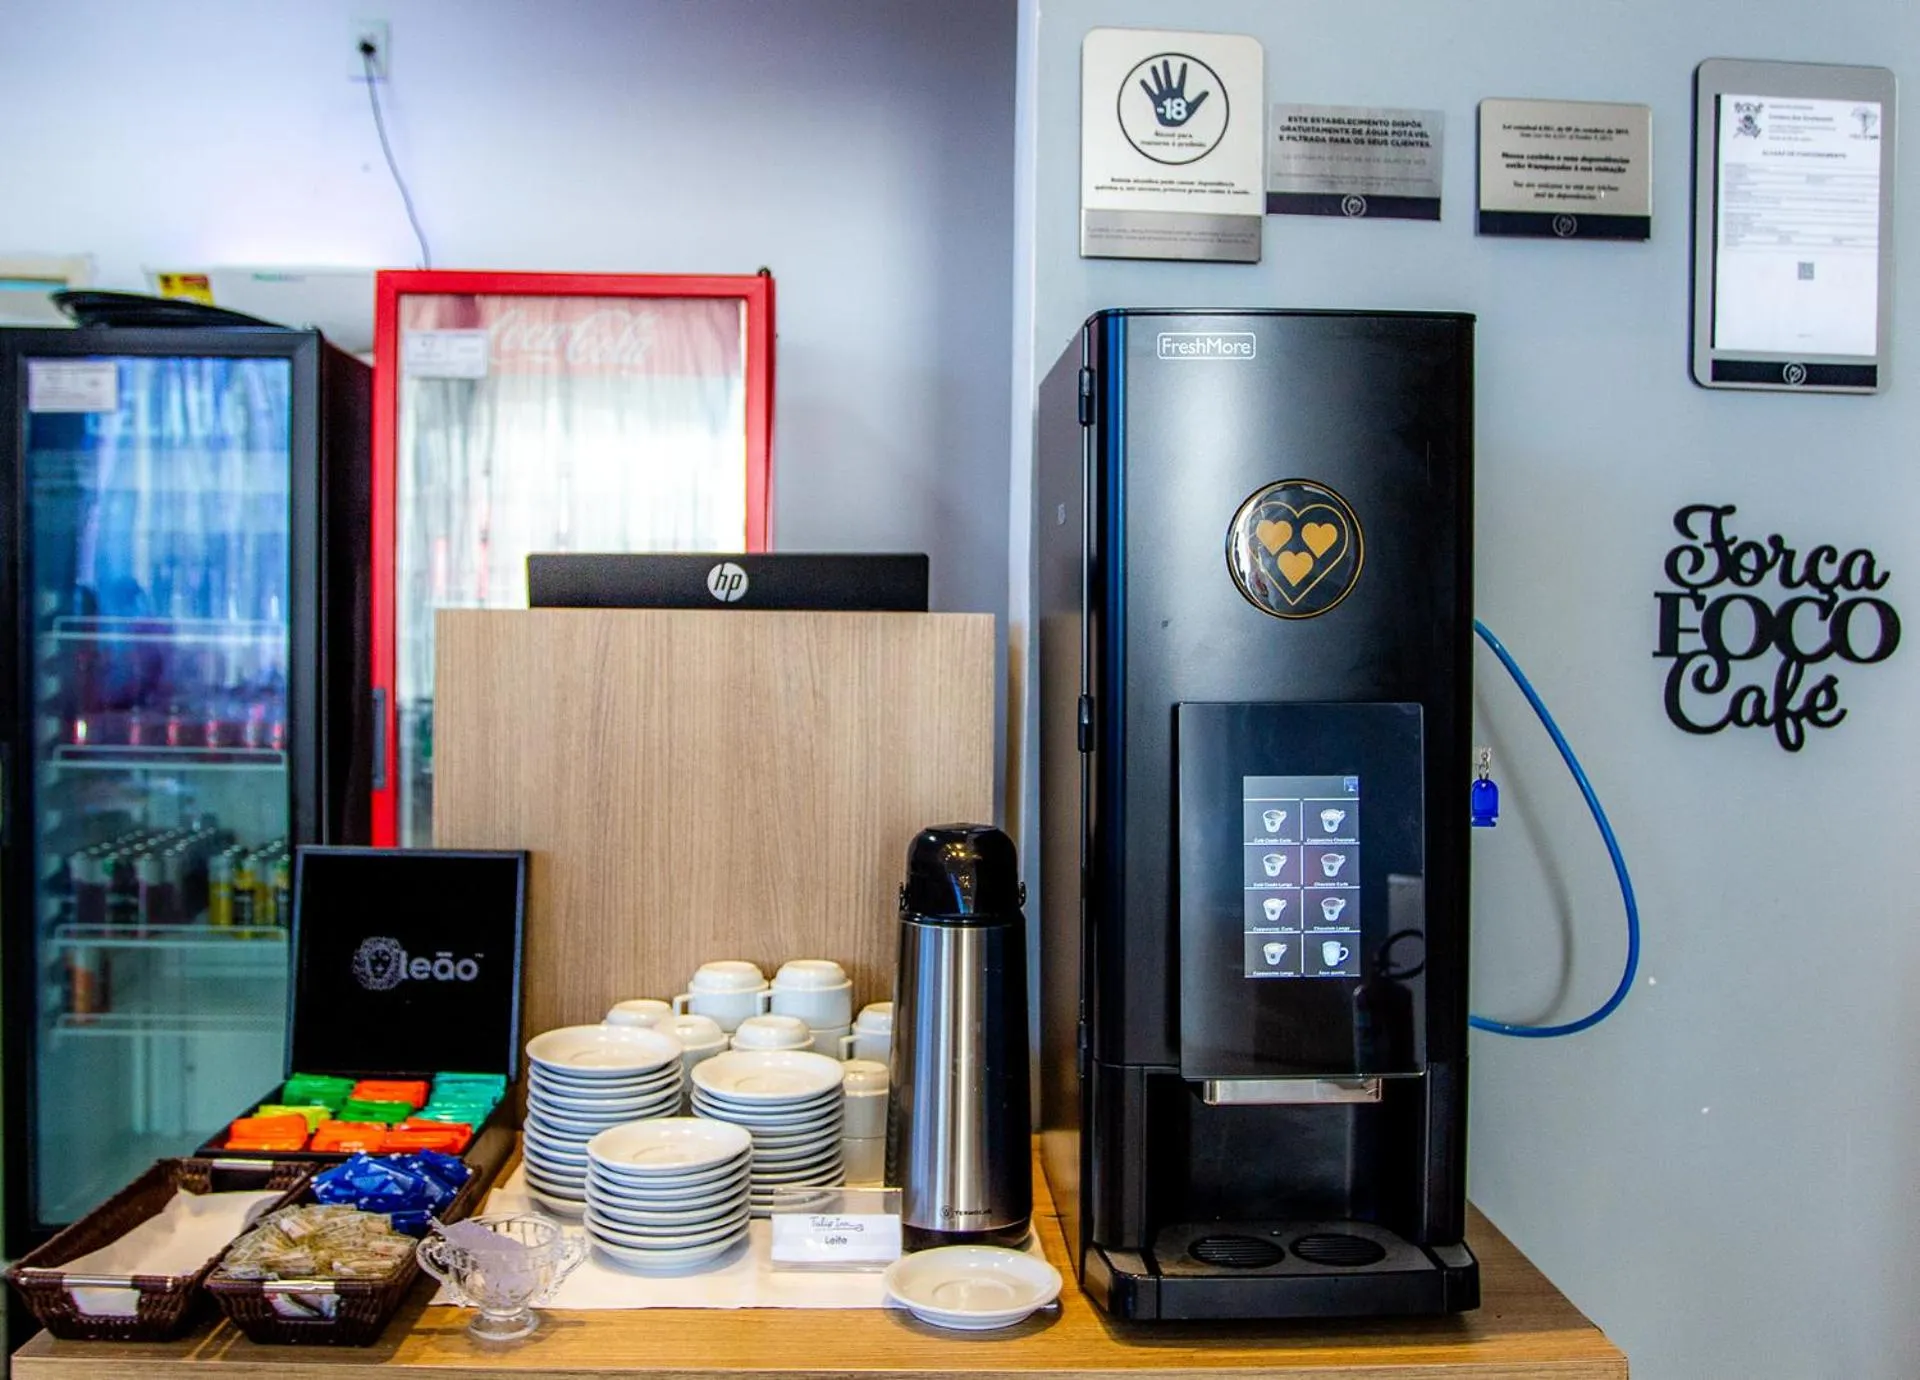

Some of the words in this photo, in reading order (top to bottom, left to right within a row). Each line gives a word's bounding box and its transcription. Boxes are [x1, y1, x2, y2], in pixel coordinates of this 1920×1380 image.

[1156, 97, 1188, 121] -18
[1287, 115, 1308, 124] ESTE
[1310, 116, 1390, 128] ESTABELECIMENTO
[1279, 124, 1350, 135] GRATUITAMENTE
[1351, 127, 1364, 136] DE
[1391, 128, 1430, 139] POTÁVEL
[1286, 134, 1327, 144] FILTRADA
[1328, 135, 1352, 145] PARA
[1353, 136, 1366, 146] OS
[1367, 137, 1389, 147] SEUS
[488, 308, 662, 365] Coca-Cola
[1162, 337, 1251, 355] FreshMore
[1664, 504, 1891, 598] Força
[711, 562, 746, 602] hp
[1652, 592, 1902, 664] FOCO
[1664, 650, 1848, 752] Café
[400, 950, 479, 980] leão
[824, 1235, 848, 1246] Leite
